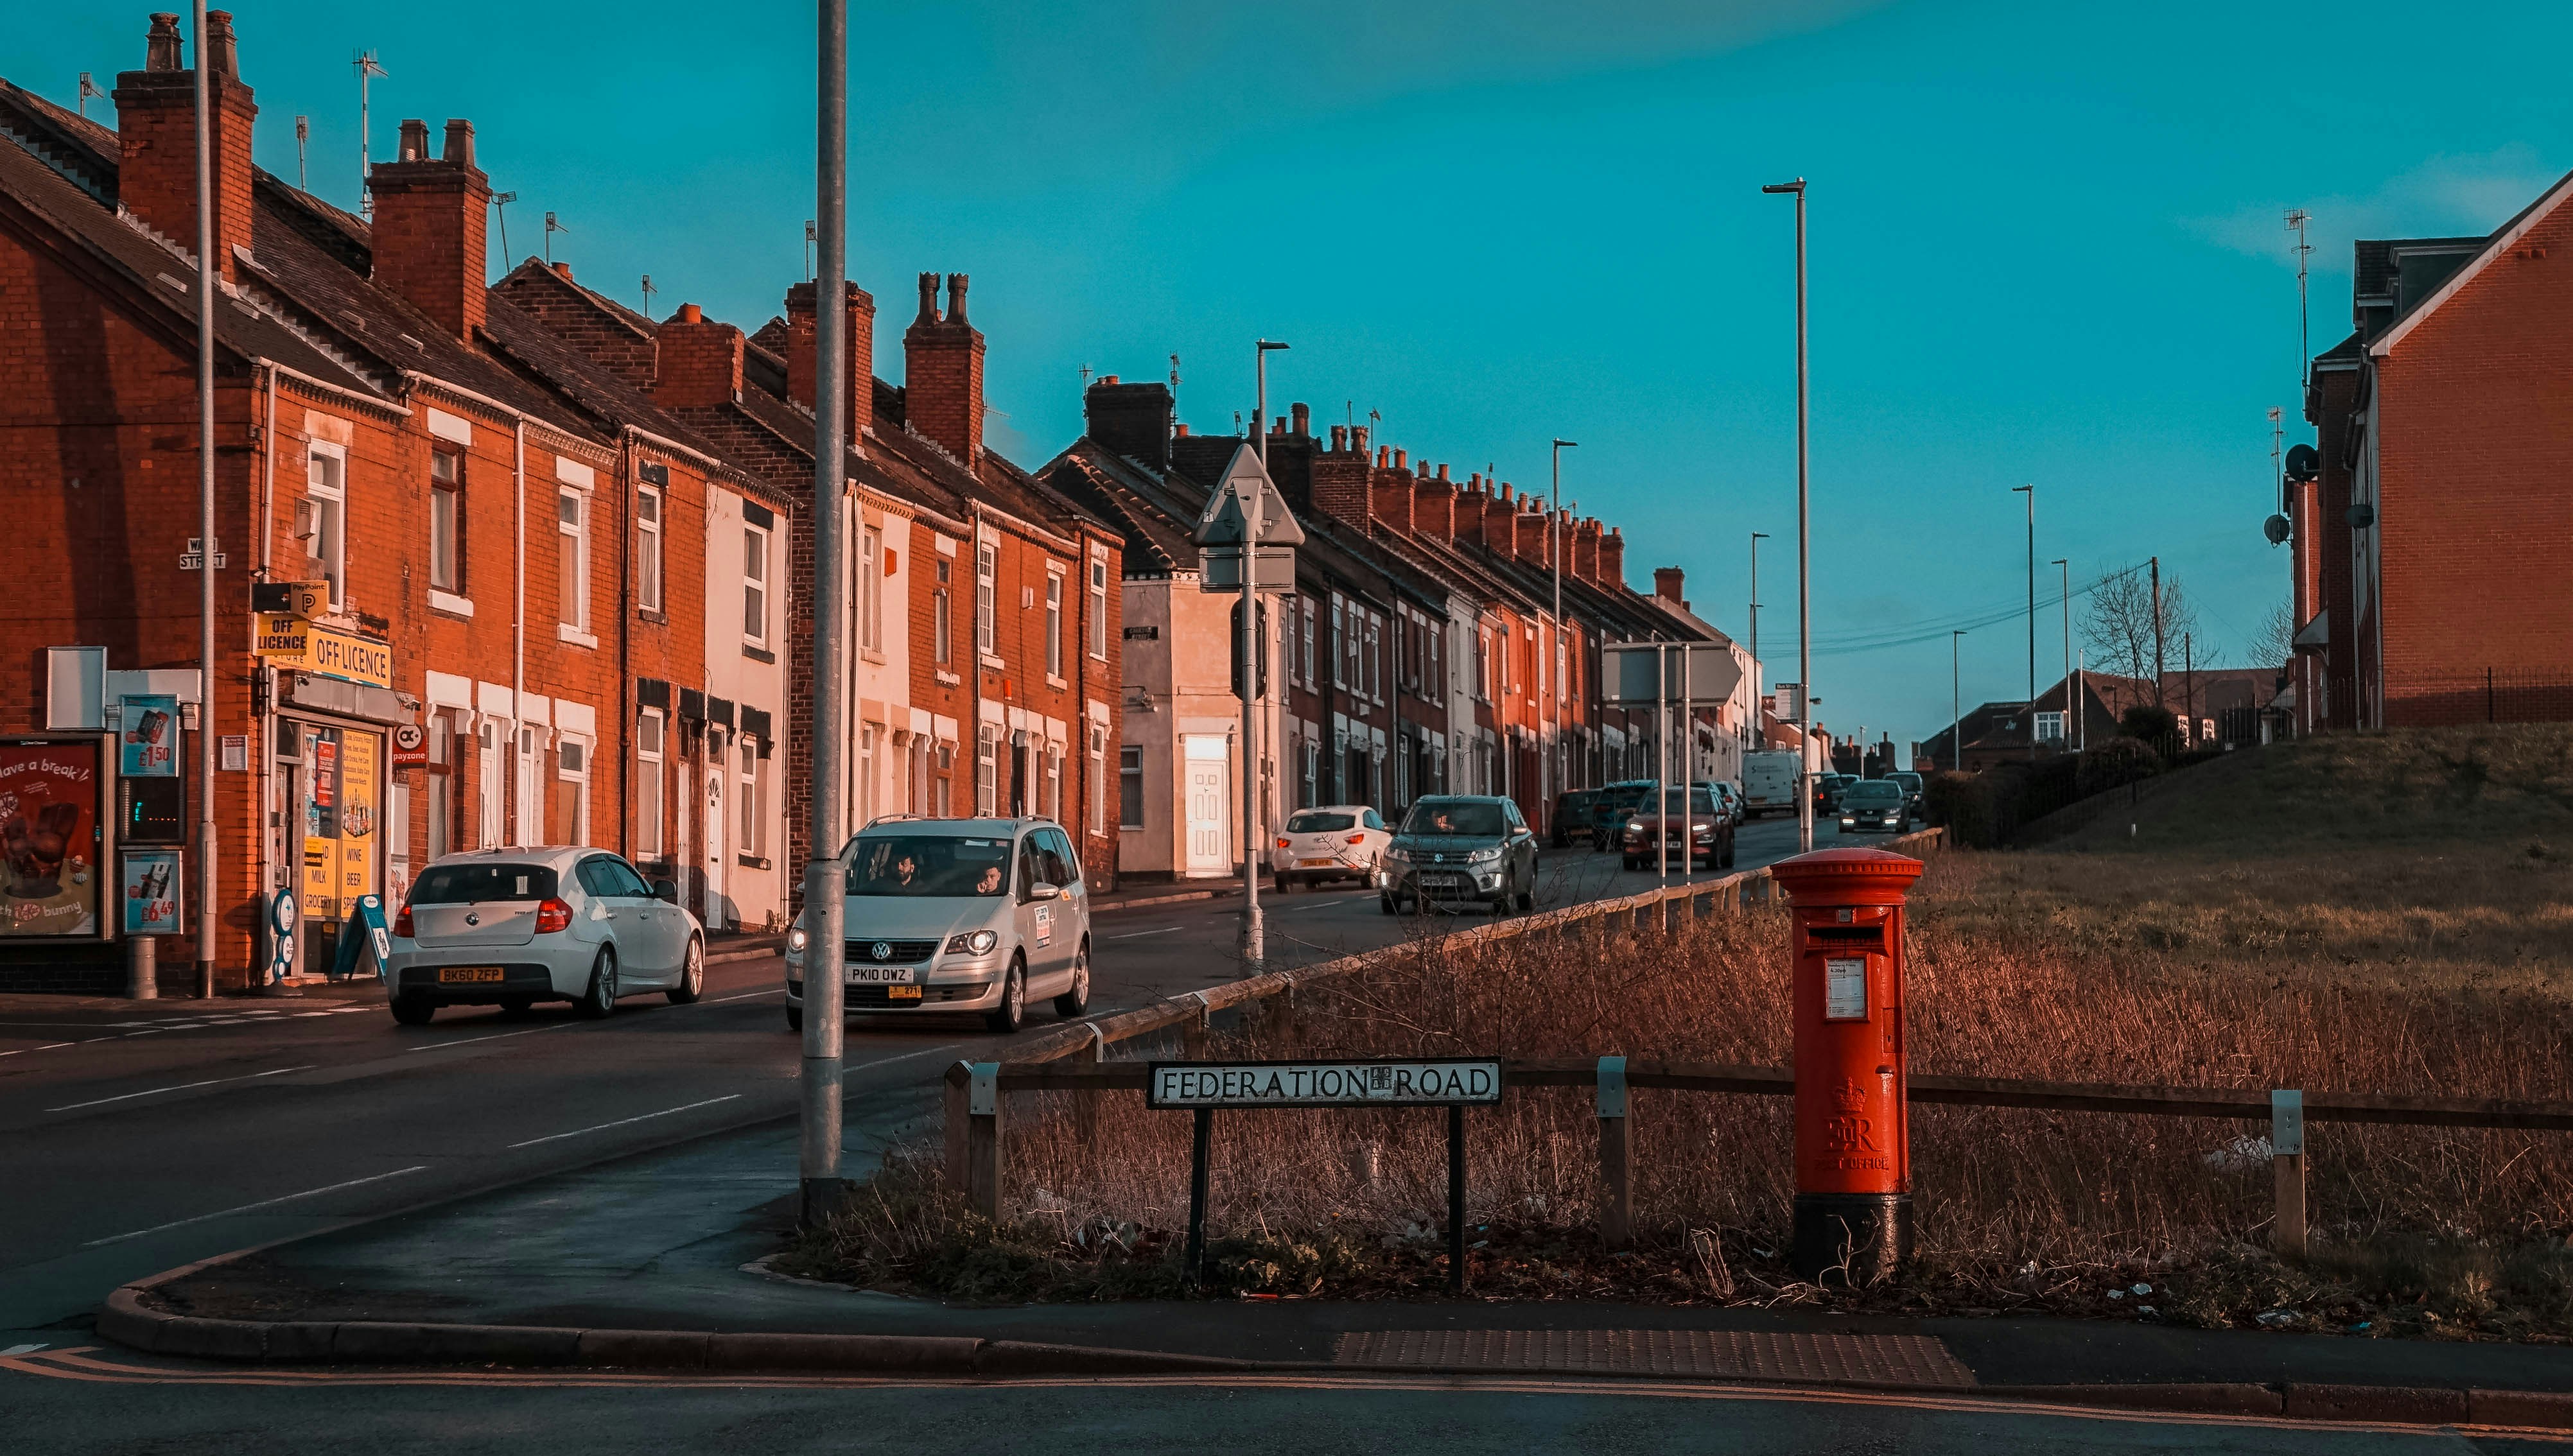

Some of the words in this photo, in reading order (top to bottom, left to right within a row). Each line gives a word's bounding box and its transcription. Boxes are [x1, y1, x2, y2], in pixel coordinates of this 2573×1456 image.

[272, 619, 293, 633] OFF
[257, 635, 307, 650] LICENCE
[317, 638, 339, 667] OFF
[342, 643, 386, 679] LICENCE
[393, 752, 425, 762] payzone
[29, 761, 37, 770] a
[346, 847, 362, 862] WINE
[311, 869, 326, 883] MILK
[347, 872, 361, 887] BEER
[42, 901, 82, 917] bunny
[305, 894, 332, 910] GROCERY
[444, 970, 473, 981] BK60
[477, 969, 499, 980] ZFP
[853, 969, 879, 981] PK10
[882, 969, 906, 981] OWZ
[1162, 1068, 1368, 1098] FEDERATION
[1395, 1068, 1491, 1096] ROAD
